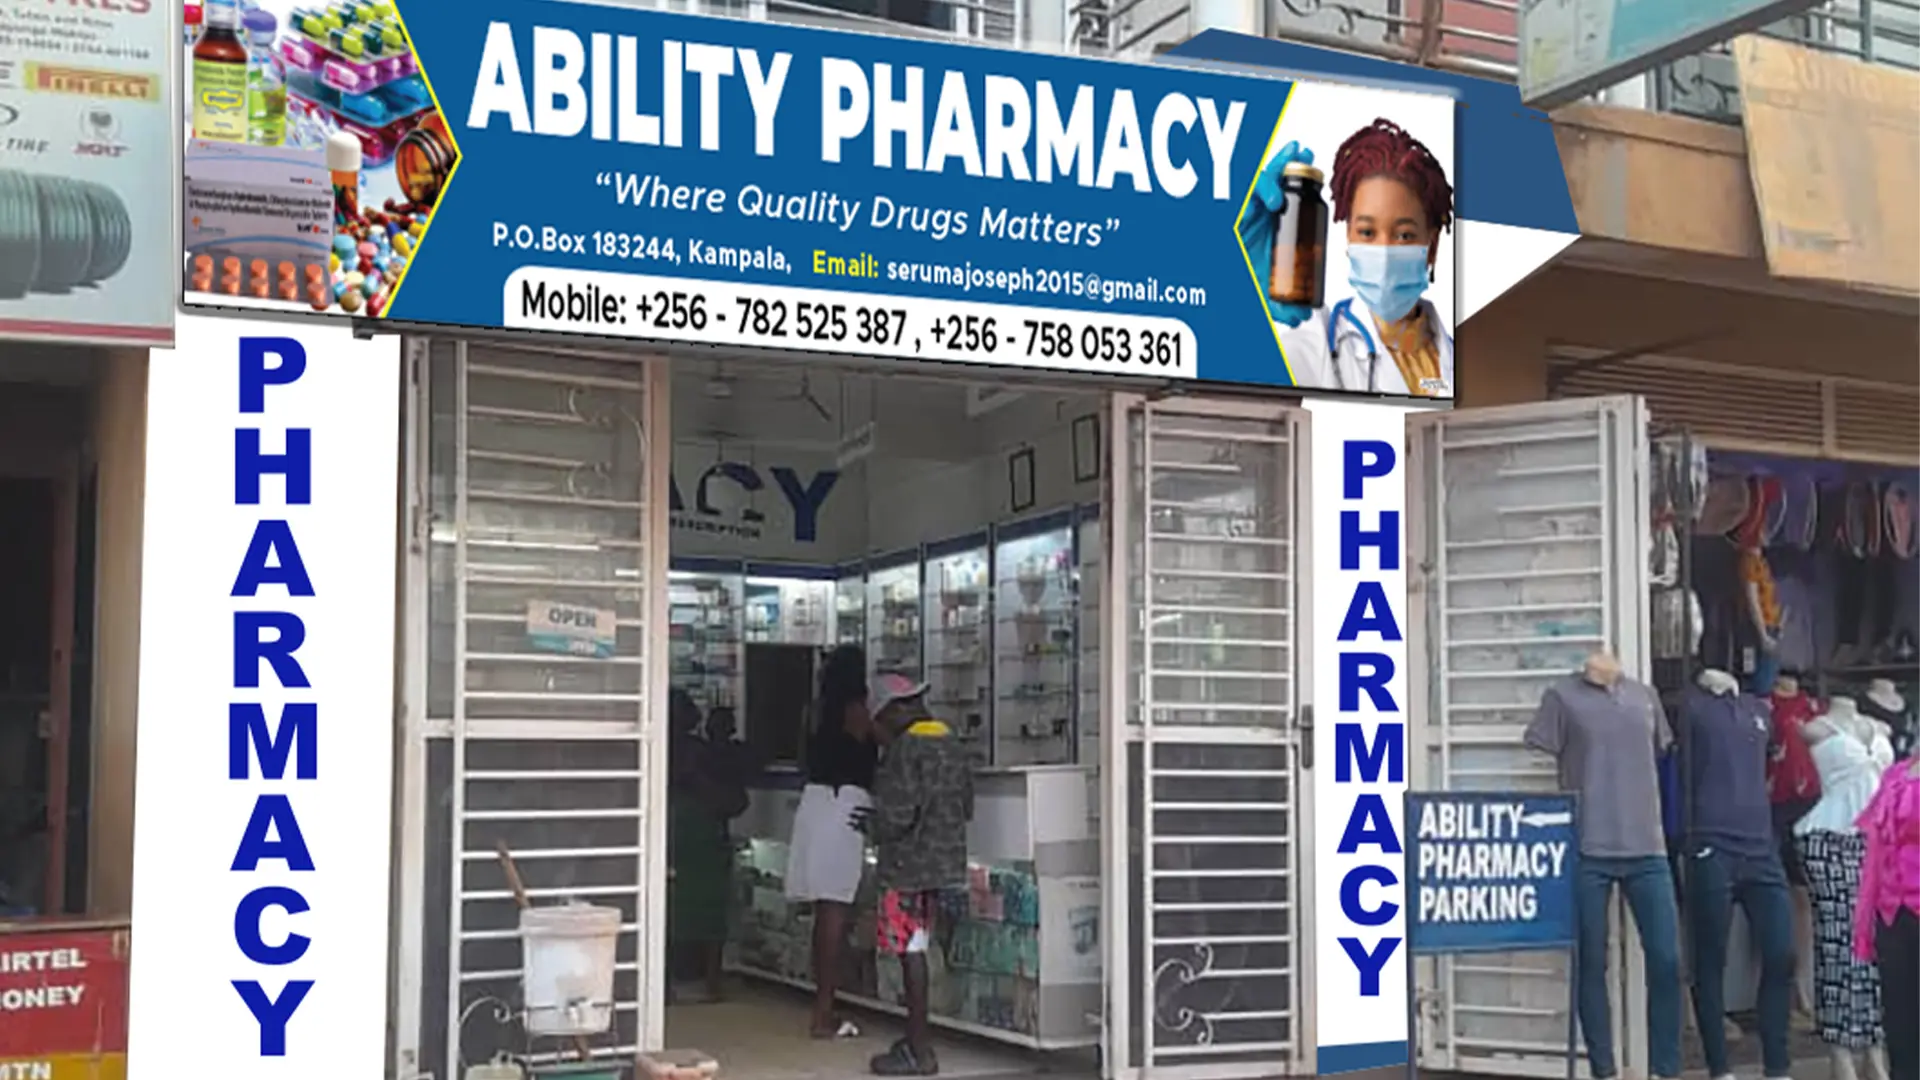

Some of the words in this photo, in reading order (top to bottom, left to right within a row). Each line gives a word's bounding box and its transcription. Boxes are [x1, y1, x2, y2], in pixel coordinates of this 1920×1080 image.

[466, 21, 793, 156] ABILITY
[821, 57, 1248, 200] PHARMACY
[596, 172, 726, 213] “Where
[737, 184, 861, 232] Quality
[870, 196, 968, 240] Drugs
[979, 206, 1121, 247] Matters”
[493, 221, 585, 254] P.O.Box
[592, 231, 681, 265] 183244,
[689, 239, 792, 274] Kampala,
[813, 249, 878, 280] Email:
[887, 262, 1206, 305] serumajoseph2015@gmail.com
[522, 279, 627, 325] Mobile:
[636, 291, 708, 331] +256
[735, 296, 788, 337] 782
[796, 302, 848, 342] 525
[856, 308, 907, 346] 387
[930, 317, 998, 353] +256
[1024, 324, 1074, 358] 758
[1080, 330, 1132, 363] 053
[1139, 336, 1181, 367] 361
[548, 607, 597, 628] OPEN
[229, 337, 318, 1056] PHARMACY
[1335, 440, 1404, 997] PHARMACY
[1418, 802, 1525, 839] ABILITY
[1417, 841, 1567, 879] PHARMACY
[1418, 884, 1538, 922] PARKING
[0, 948, 87, 973] IRTEL
[0, 984, 85, 1010] ONEY
